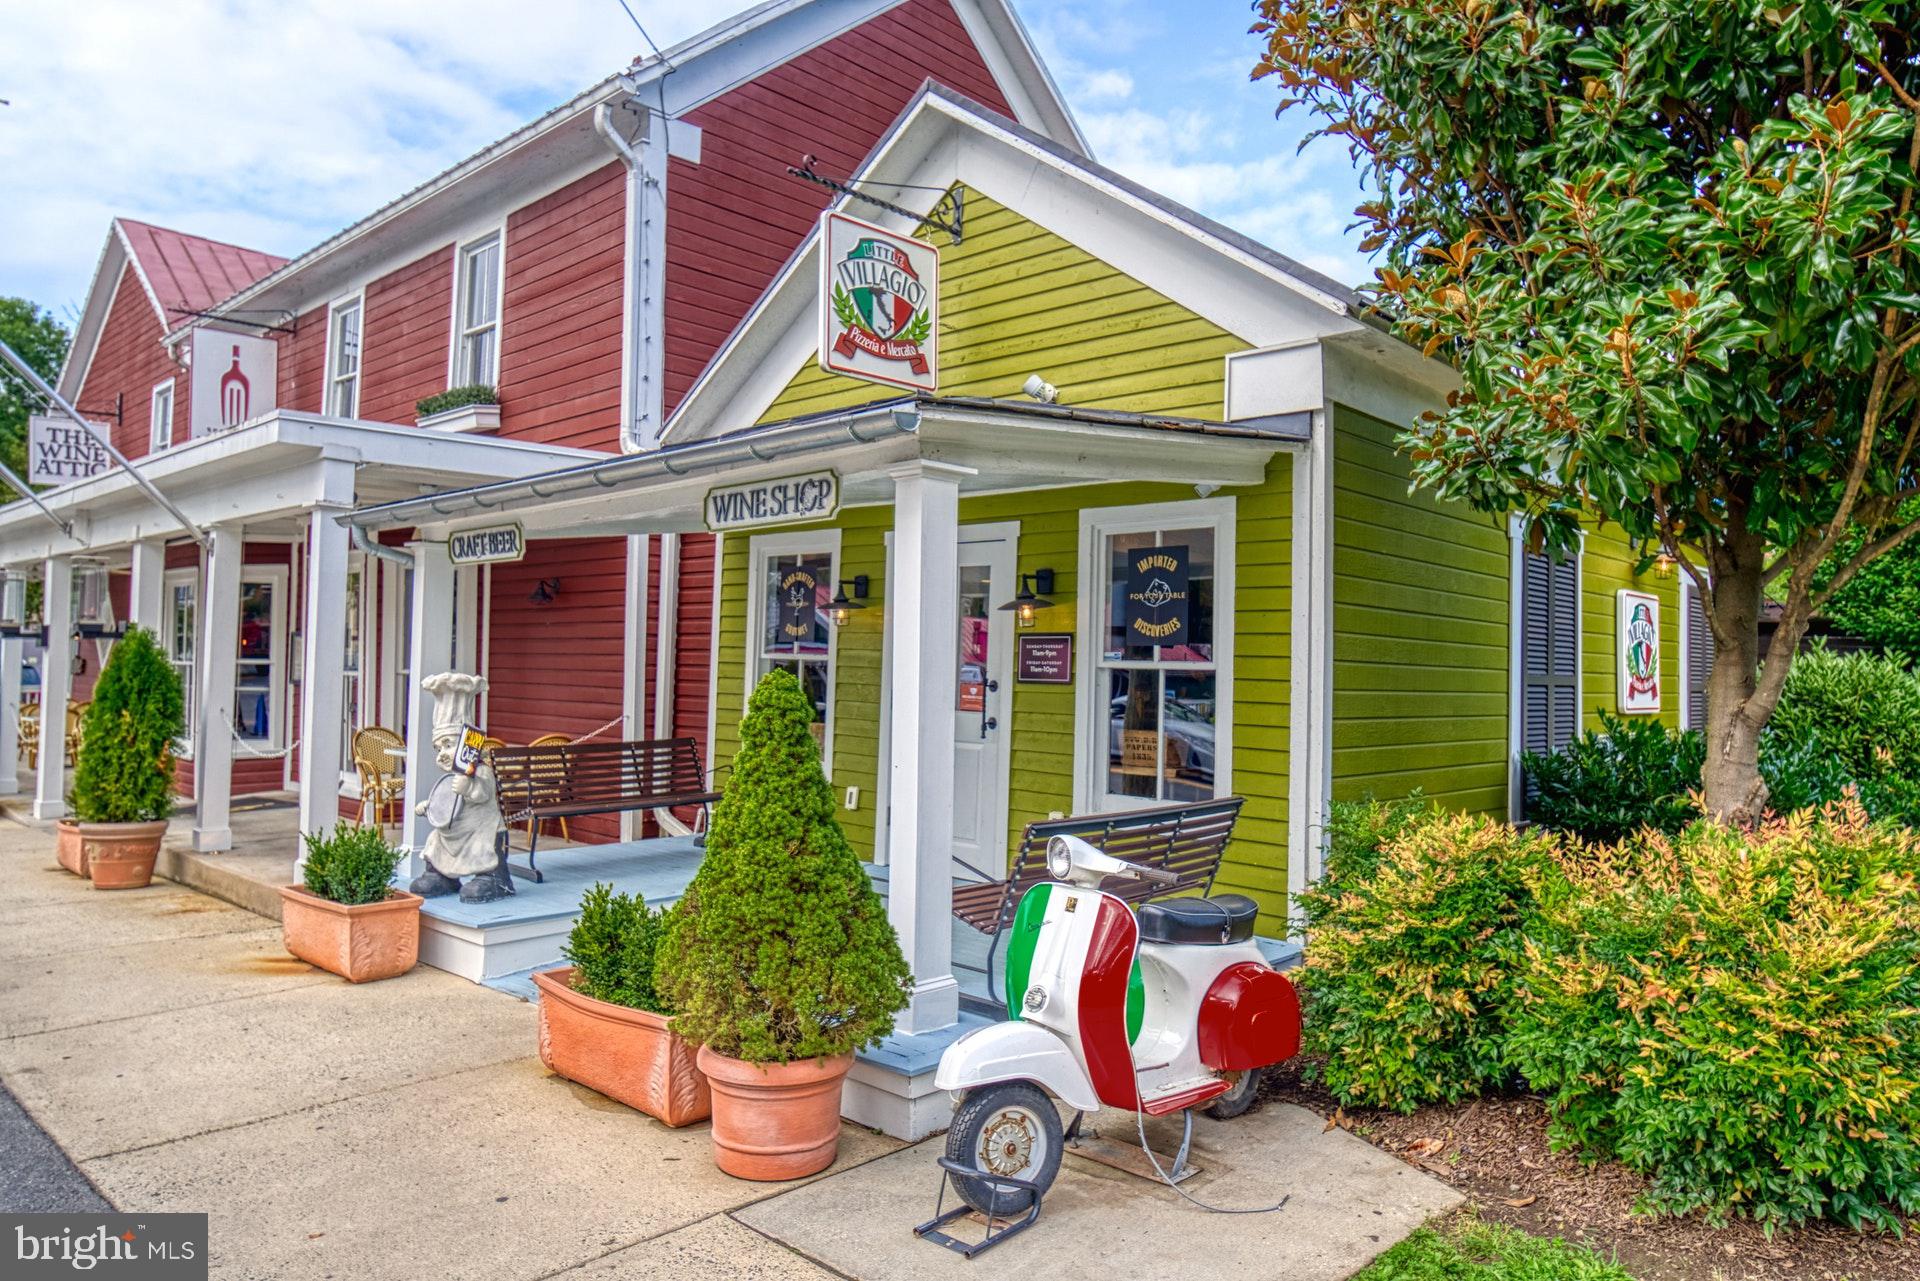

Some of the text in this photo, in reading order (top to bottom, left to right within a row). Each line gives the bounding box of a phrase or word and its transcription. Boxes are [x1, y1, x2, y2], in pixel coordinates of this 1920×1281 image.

[863, 242, 905, 267] LITTLE
[841, 260, 921, 305] VILLAGIO
[850, 326, 917, 357] Pizzeria e Mercato
[46, 427, 97, 446] THE
[36, 442, 107, 462] WINE
[35, 459, 107, 477] ATTIC
[712, 478, 832, 524] WINE SHOP
[452, 529, 520, 559] CRAFT BEER
[1136, 554, 1178, 574] IMPORTED
[1165, 591, 1186, 599] TABLE
[1133, 617, 1182, 638] DISCOVERIES
